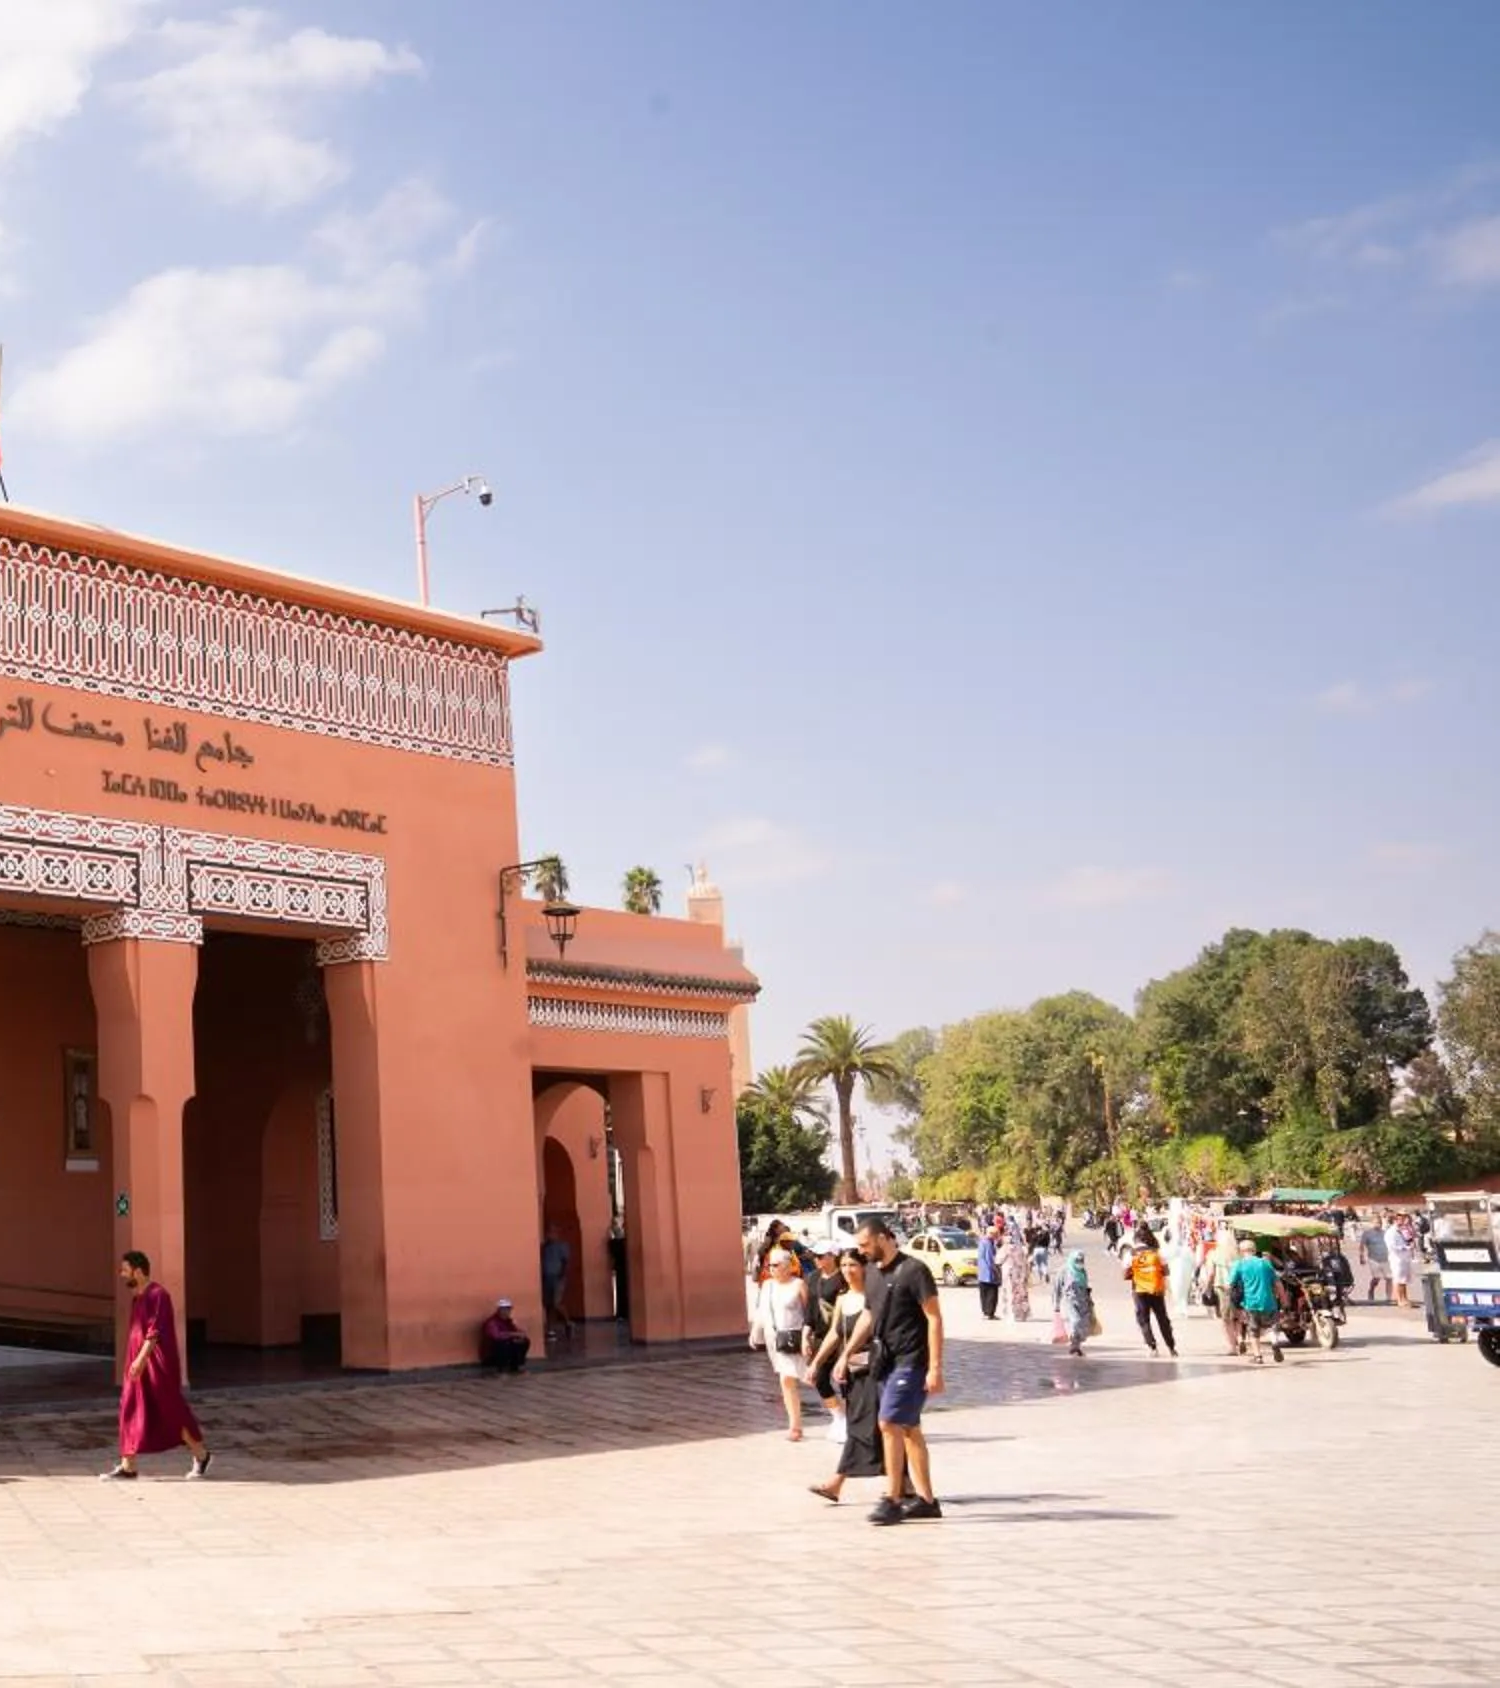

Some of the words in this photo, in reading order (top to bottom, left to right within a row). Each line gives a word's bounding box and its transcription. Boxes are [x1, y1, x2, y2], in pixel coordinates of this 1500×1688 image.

[41, 701, 125, 747] متحف
[144, 717, 187, 755] الفنا
[196, 730, 255, 773] جامع
